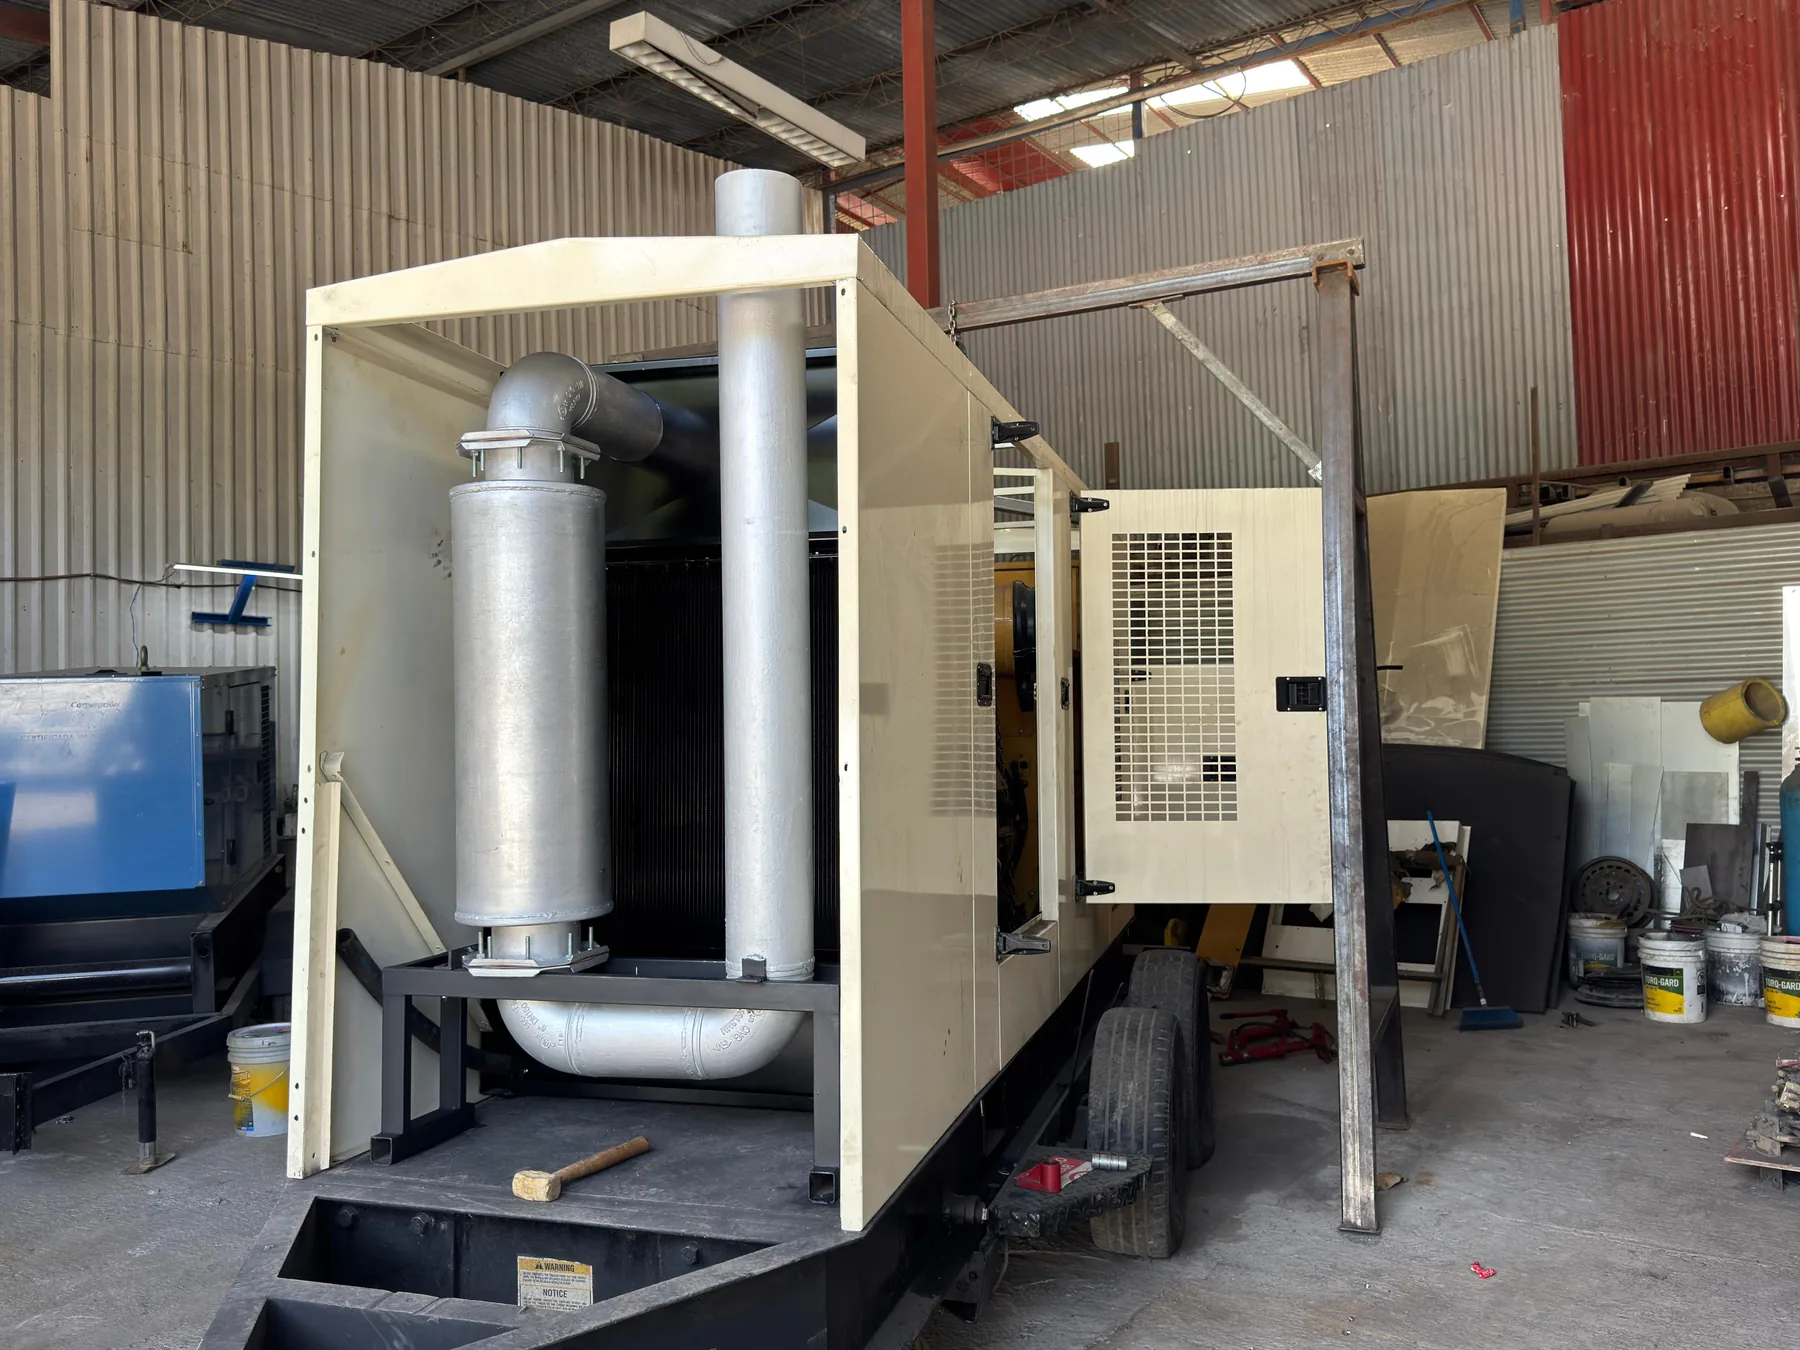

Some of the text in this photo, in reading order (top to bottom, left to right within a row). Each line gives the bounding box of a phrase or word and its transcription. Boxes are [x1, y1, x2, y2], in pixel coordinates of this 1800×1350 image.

[1644, 975, 1680, 988] TORQ-GARD
[1765, 977, 1800, 991] TORQ-GARD
[544, 1262, 575, 1272] WARNING
[542, 1288, 568, 1298] NOTICE
